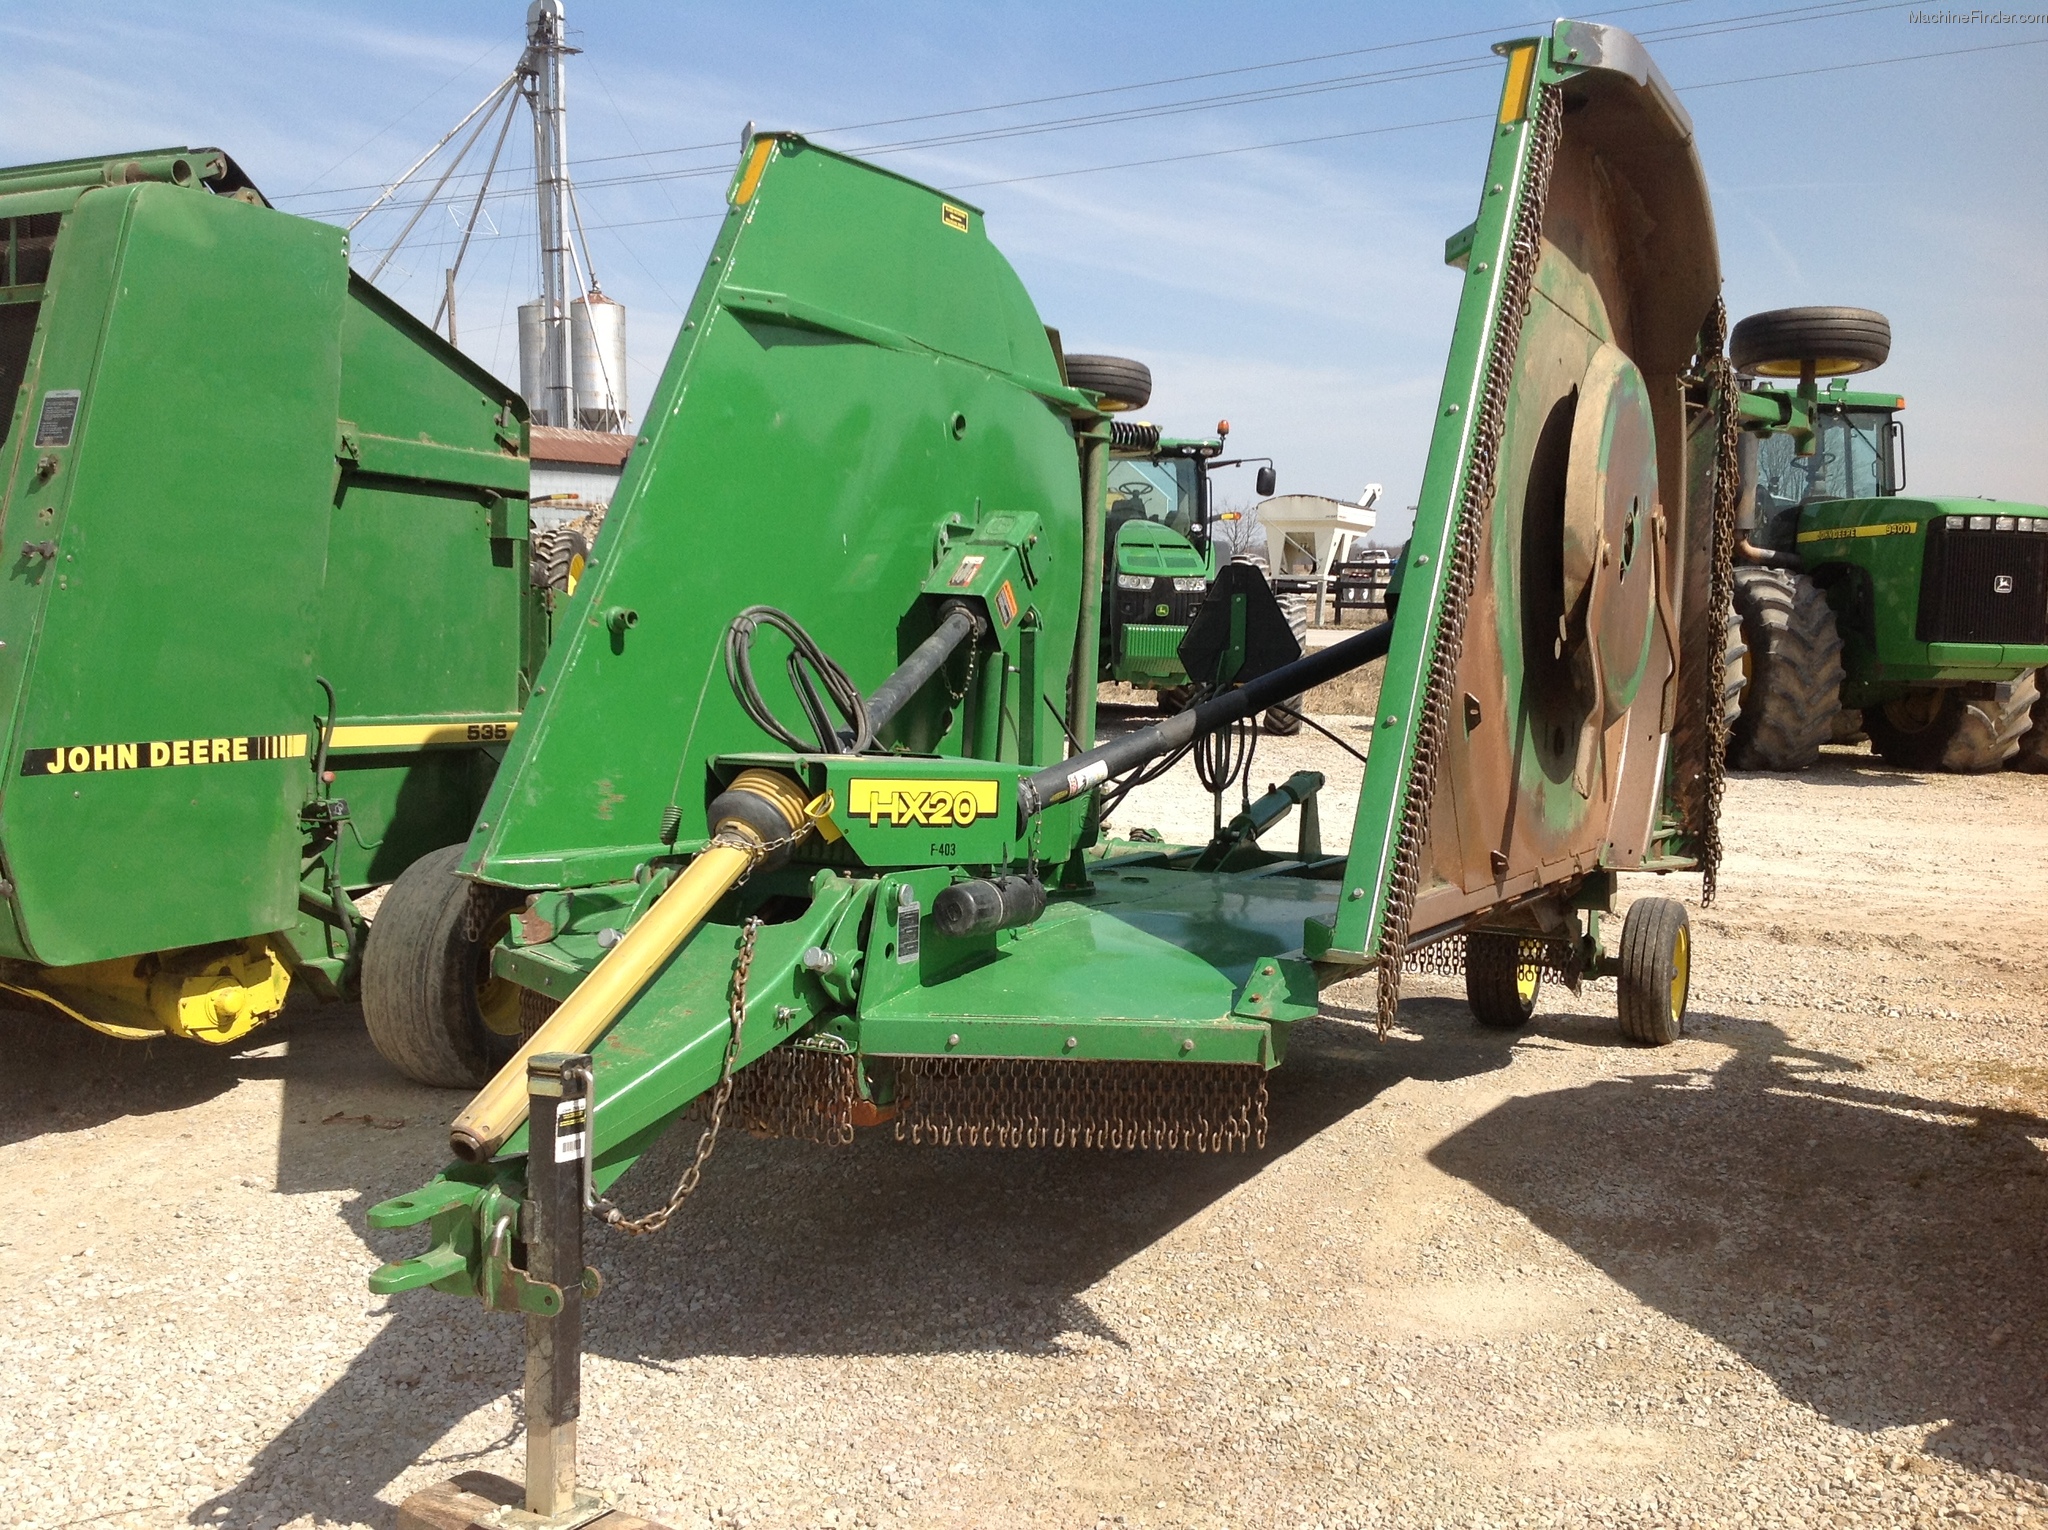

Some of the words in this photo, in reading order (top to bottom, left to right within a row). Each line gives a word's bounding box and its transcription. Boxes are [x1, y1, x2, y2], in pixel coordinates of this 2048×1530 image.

[1885, 523, 1911, 535] 9400
[467, 724, 507, 740] 535
[46, 743, 138, 774] JOHN
[150, 737, 248, 767] DEERE
[869, 790, 978, 828] HX20
[930, 843, 956, 856] F-403
